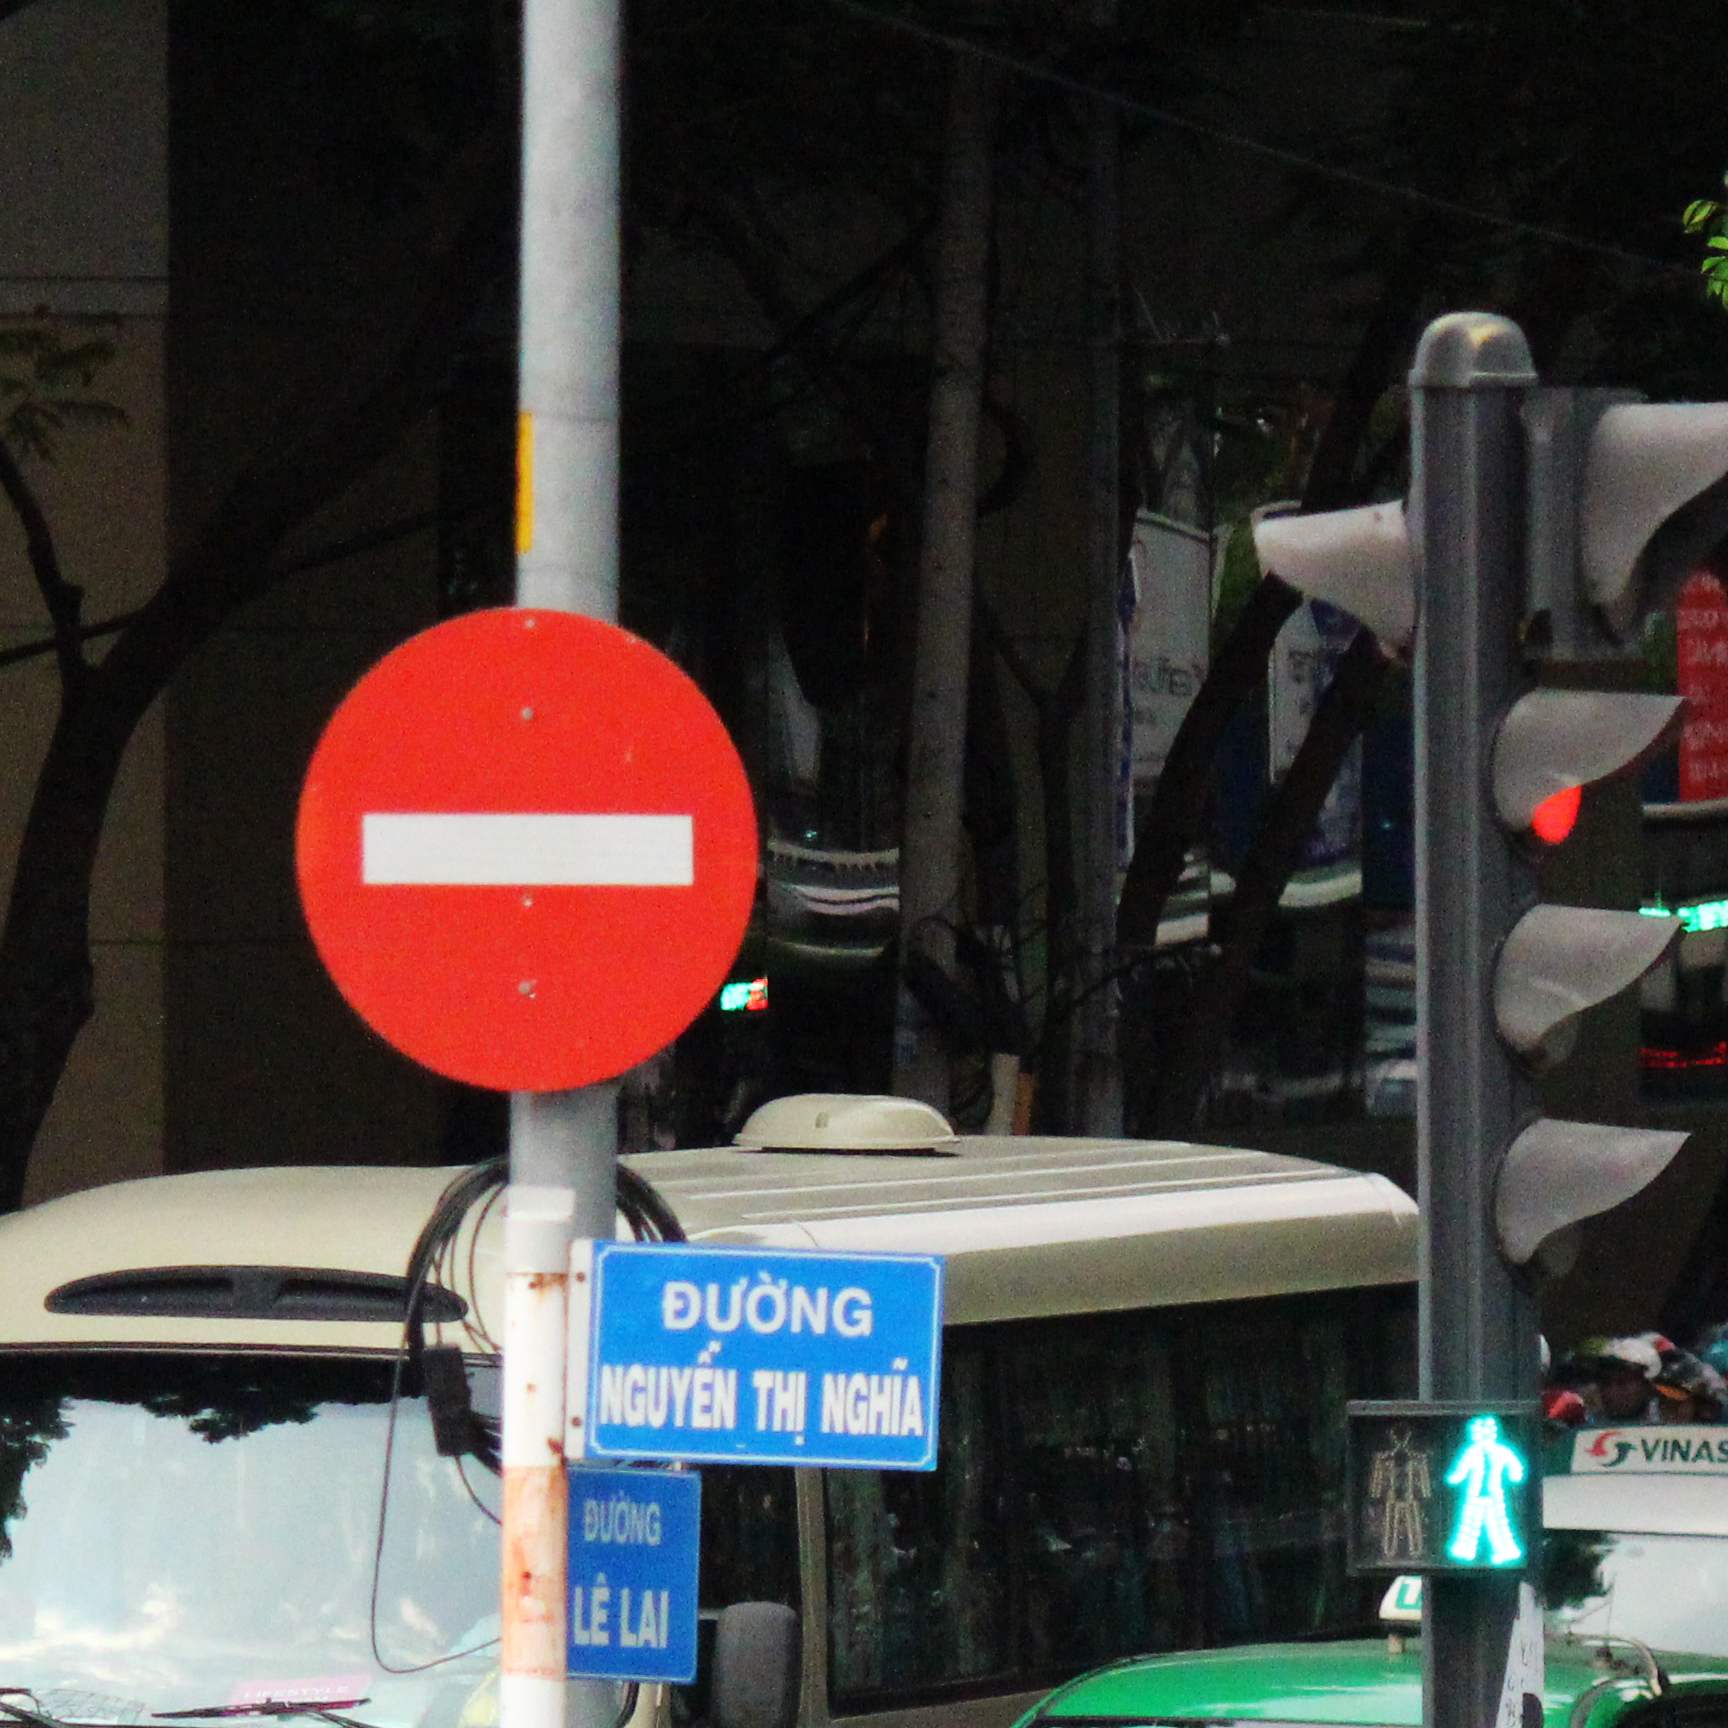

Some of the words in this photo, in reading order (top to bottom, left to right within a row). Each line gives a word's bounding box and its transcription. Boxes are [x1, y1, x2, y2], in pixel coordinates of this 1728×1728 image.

[662, 1271, 872, 1337] ĐƯỜNG
[752, 1371, 807, 1445] THỊ
[821, 1358, 924, 1436] NGHĨA
[574, 1572, 610, 1646] LÊ
[620, 1587, 669, 1649] LAI
